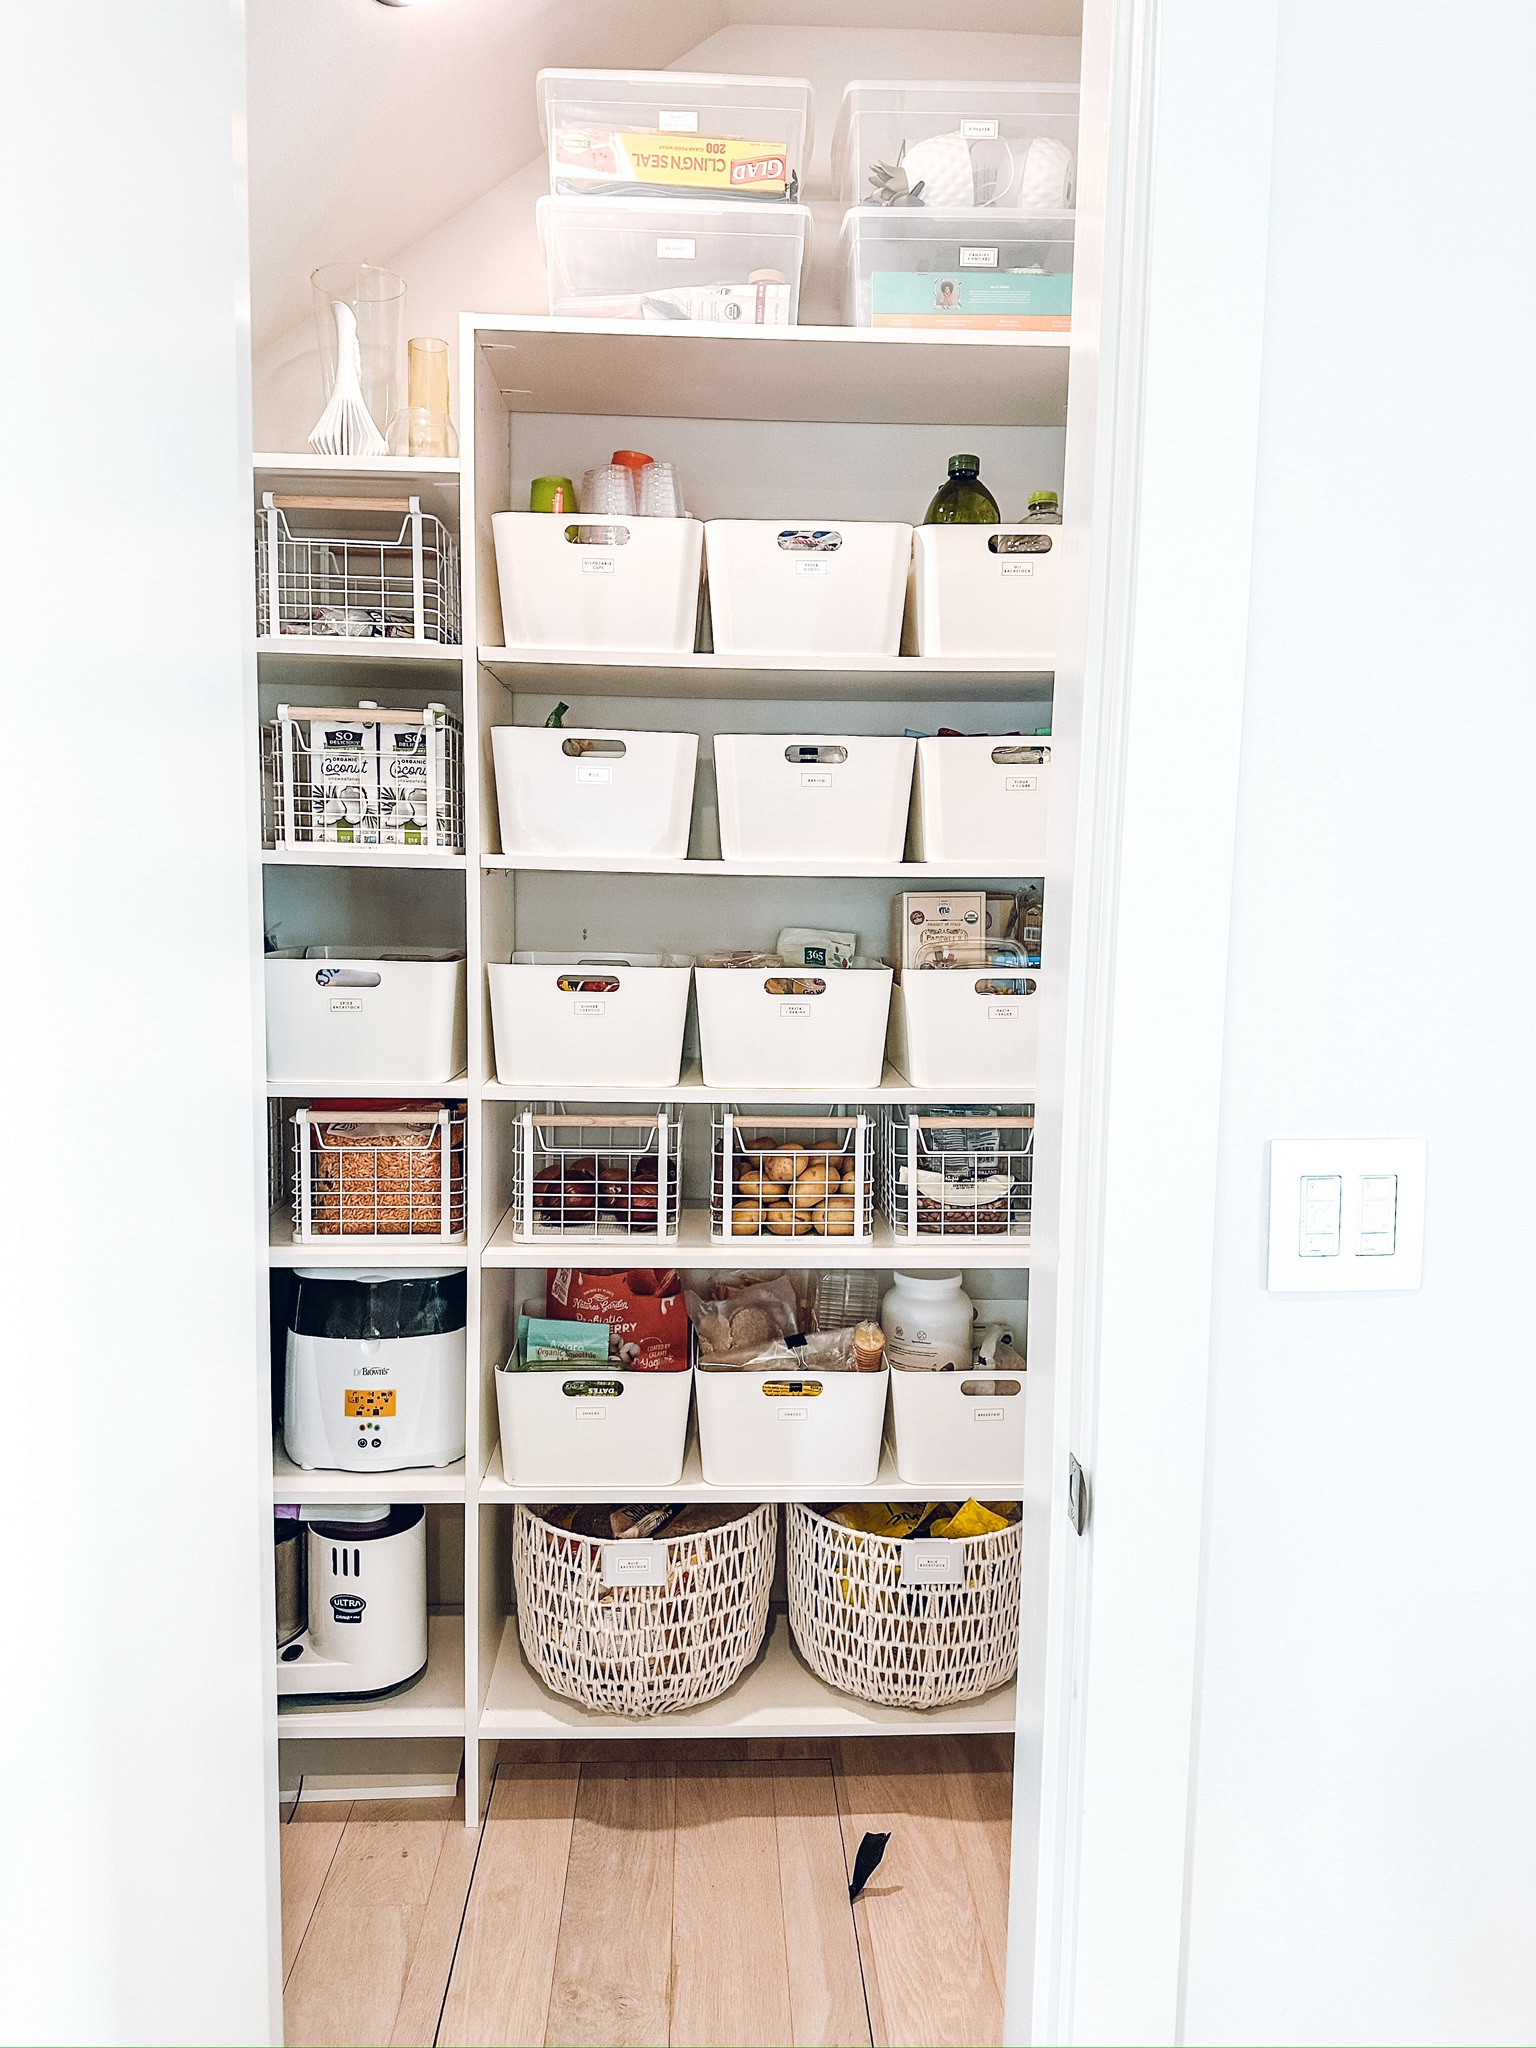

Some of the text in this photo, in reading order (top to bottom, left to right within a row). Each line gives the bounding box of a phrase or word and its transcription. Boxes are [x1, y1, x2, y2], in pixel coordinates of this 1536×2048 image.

[706, 143, 727, 155] 200
[631, 153, 669, 169] SEAL
[732, 158, 784, 182] GLAD
[335, 731, 353, 741] SO
[321, 757, 369, 776] Coconut
[806, 950, 824, 961] 365
[537, 1347, 564, 1357] Organic
[564, 1350, 597, 1359] Smoothie
[333, 1599, 361, 1607] ULTRA
